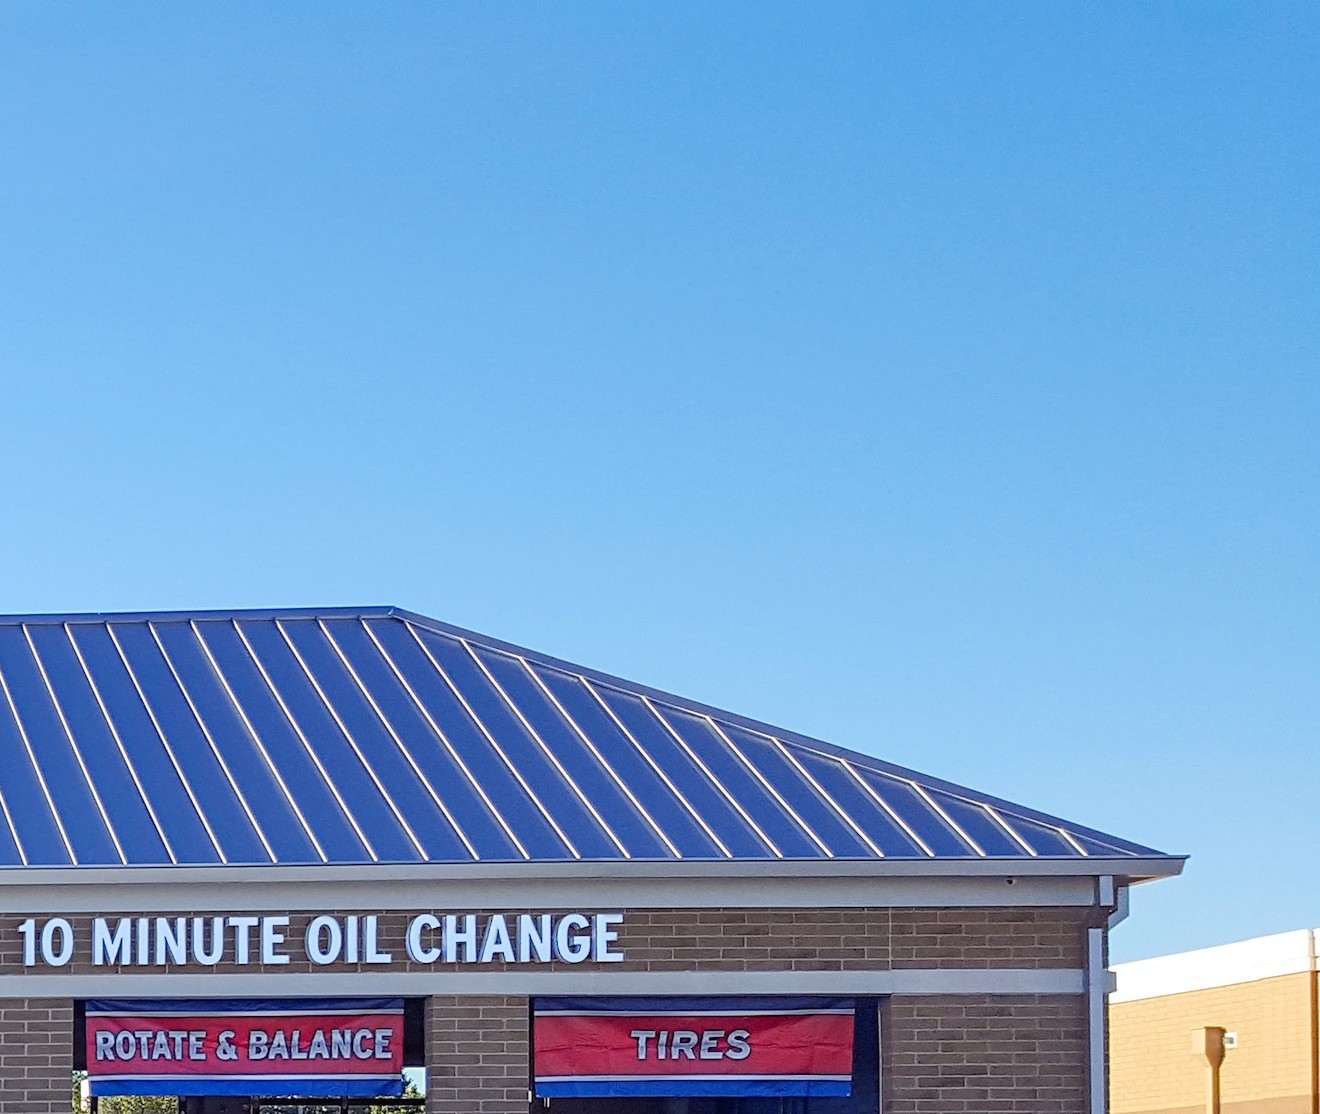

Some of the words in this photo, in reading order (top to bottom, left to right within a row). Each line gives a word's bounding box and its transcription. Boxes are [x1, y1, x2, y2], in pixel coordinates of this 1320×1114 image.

[17, 917, 75, 967] 10
[92, 915, 291, 966] MINUTE
[304, 914, 393, 965] OIL
[406, 913, 625, 965] CHANGE
[95, 1030, 207, 1061] ROTATE
[216, 1030, 239, 1061] &
[248, 1028, 393, 1060] BALANCE
[630, 1029, 751, 1060] TIRES
